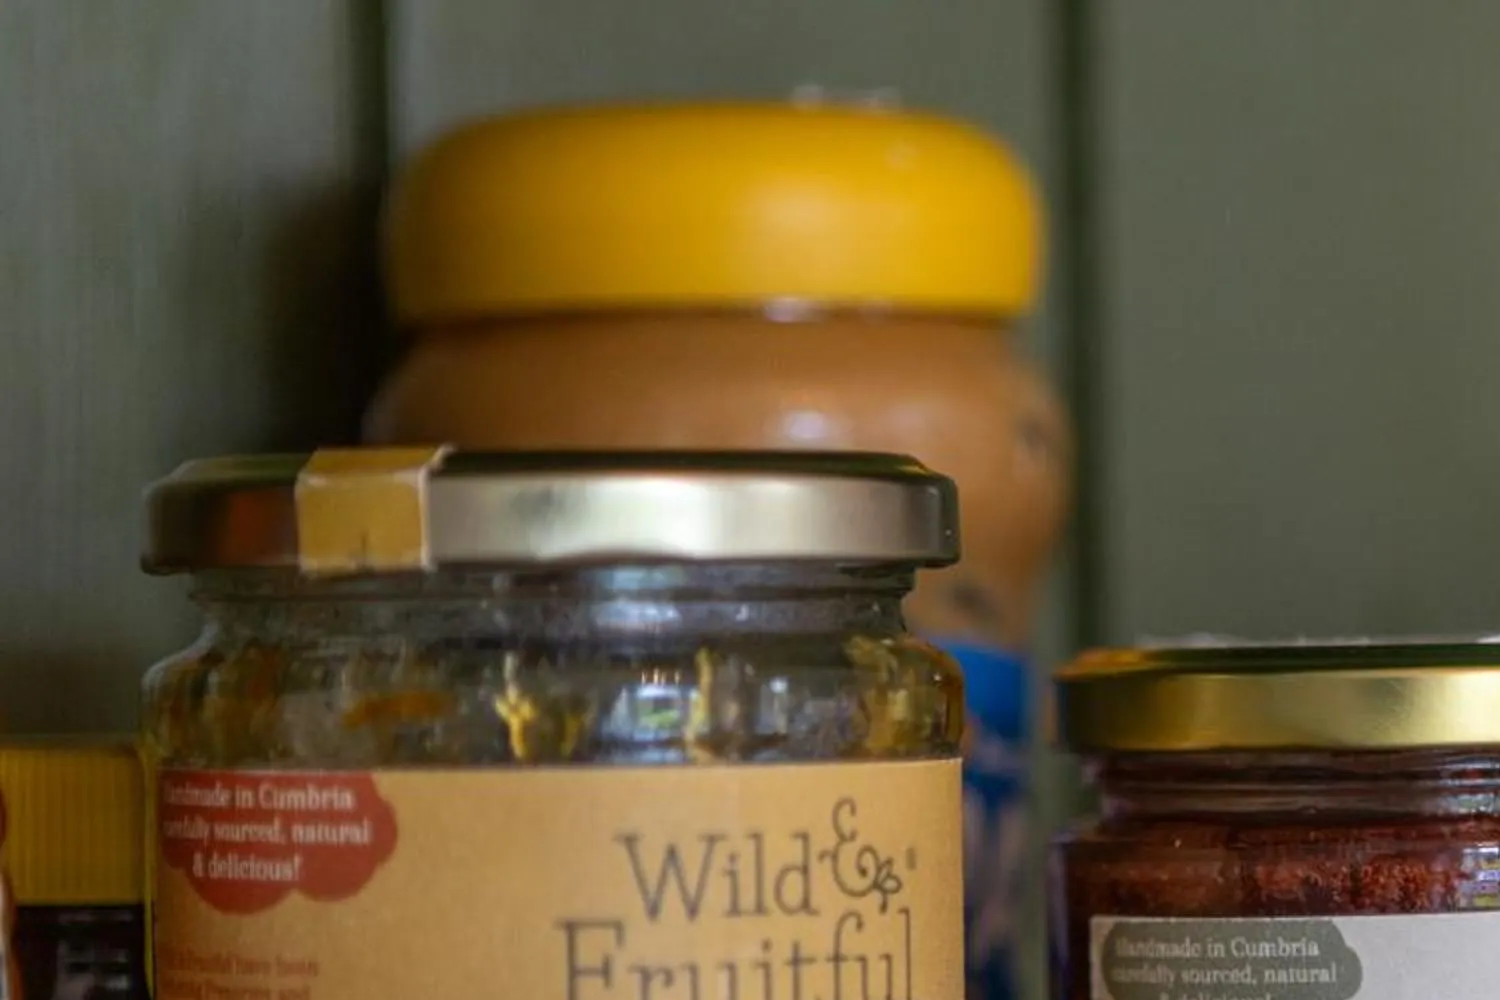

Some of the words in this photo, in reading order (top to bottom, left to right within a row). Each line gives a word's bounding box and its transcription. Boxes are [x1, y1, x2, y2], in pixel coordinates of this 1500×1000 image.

[235, 784, 254, 809] in
[258, 782, 357, 811] Cumbria
[290, 817, 372, 846] natural
[613, 830, 820, 923] Wild
[1207, 938, 1225, 958] in
[1231, 936, 1321, 958] Cumbria
[1181, 965, 1258, 985] sourced,
[1263, 961, 1338, 984] natural
